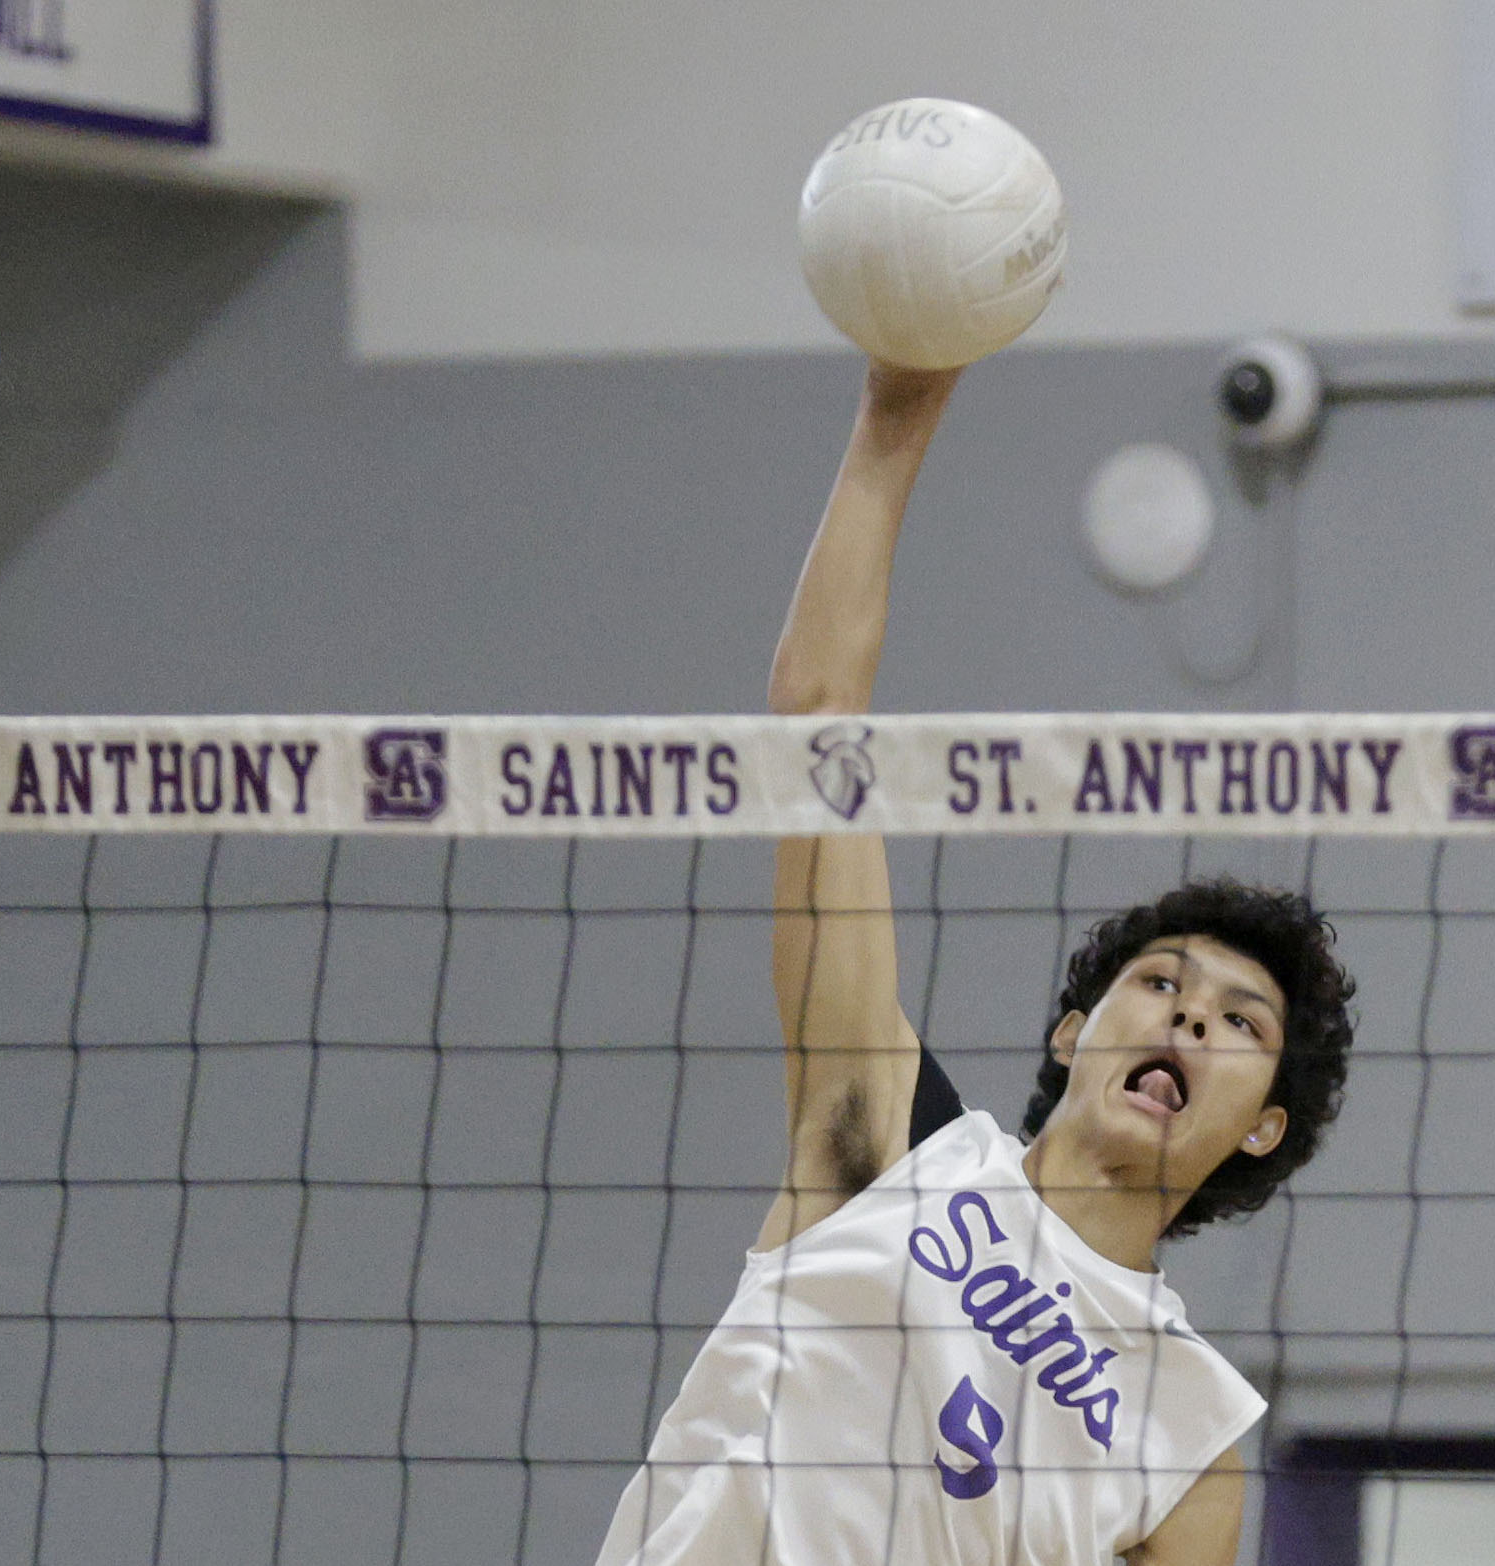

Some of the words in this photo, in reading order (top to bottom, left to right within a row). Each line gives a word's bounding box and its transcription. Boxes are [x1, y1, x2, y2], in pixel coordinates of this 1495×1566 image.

[7, 739, 320, 817] ANTHONY
[500, 741, 740, 817] SAINTS
[947, 739, 1037, 815] ST.
[1073, 738, 1403, 815] ANTHONY
[907, 1190, 1120, 1454] Saints
